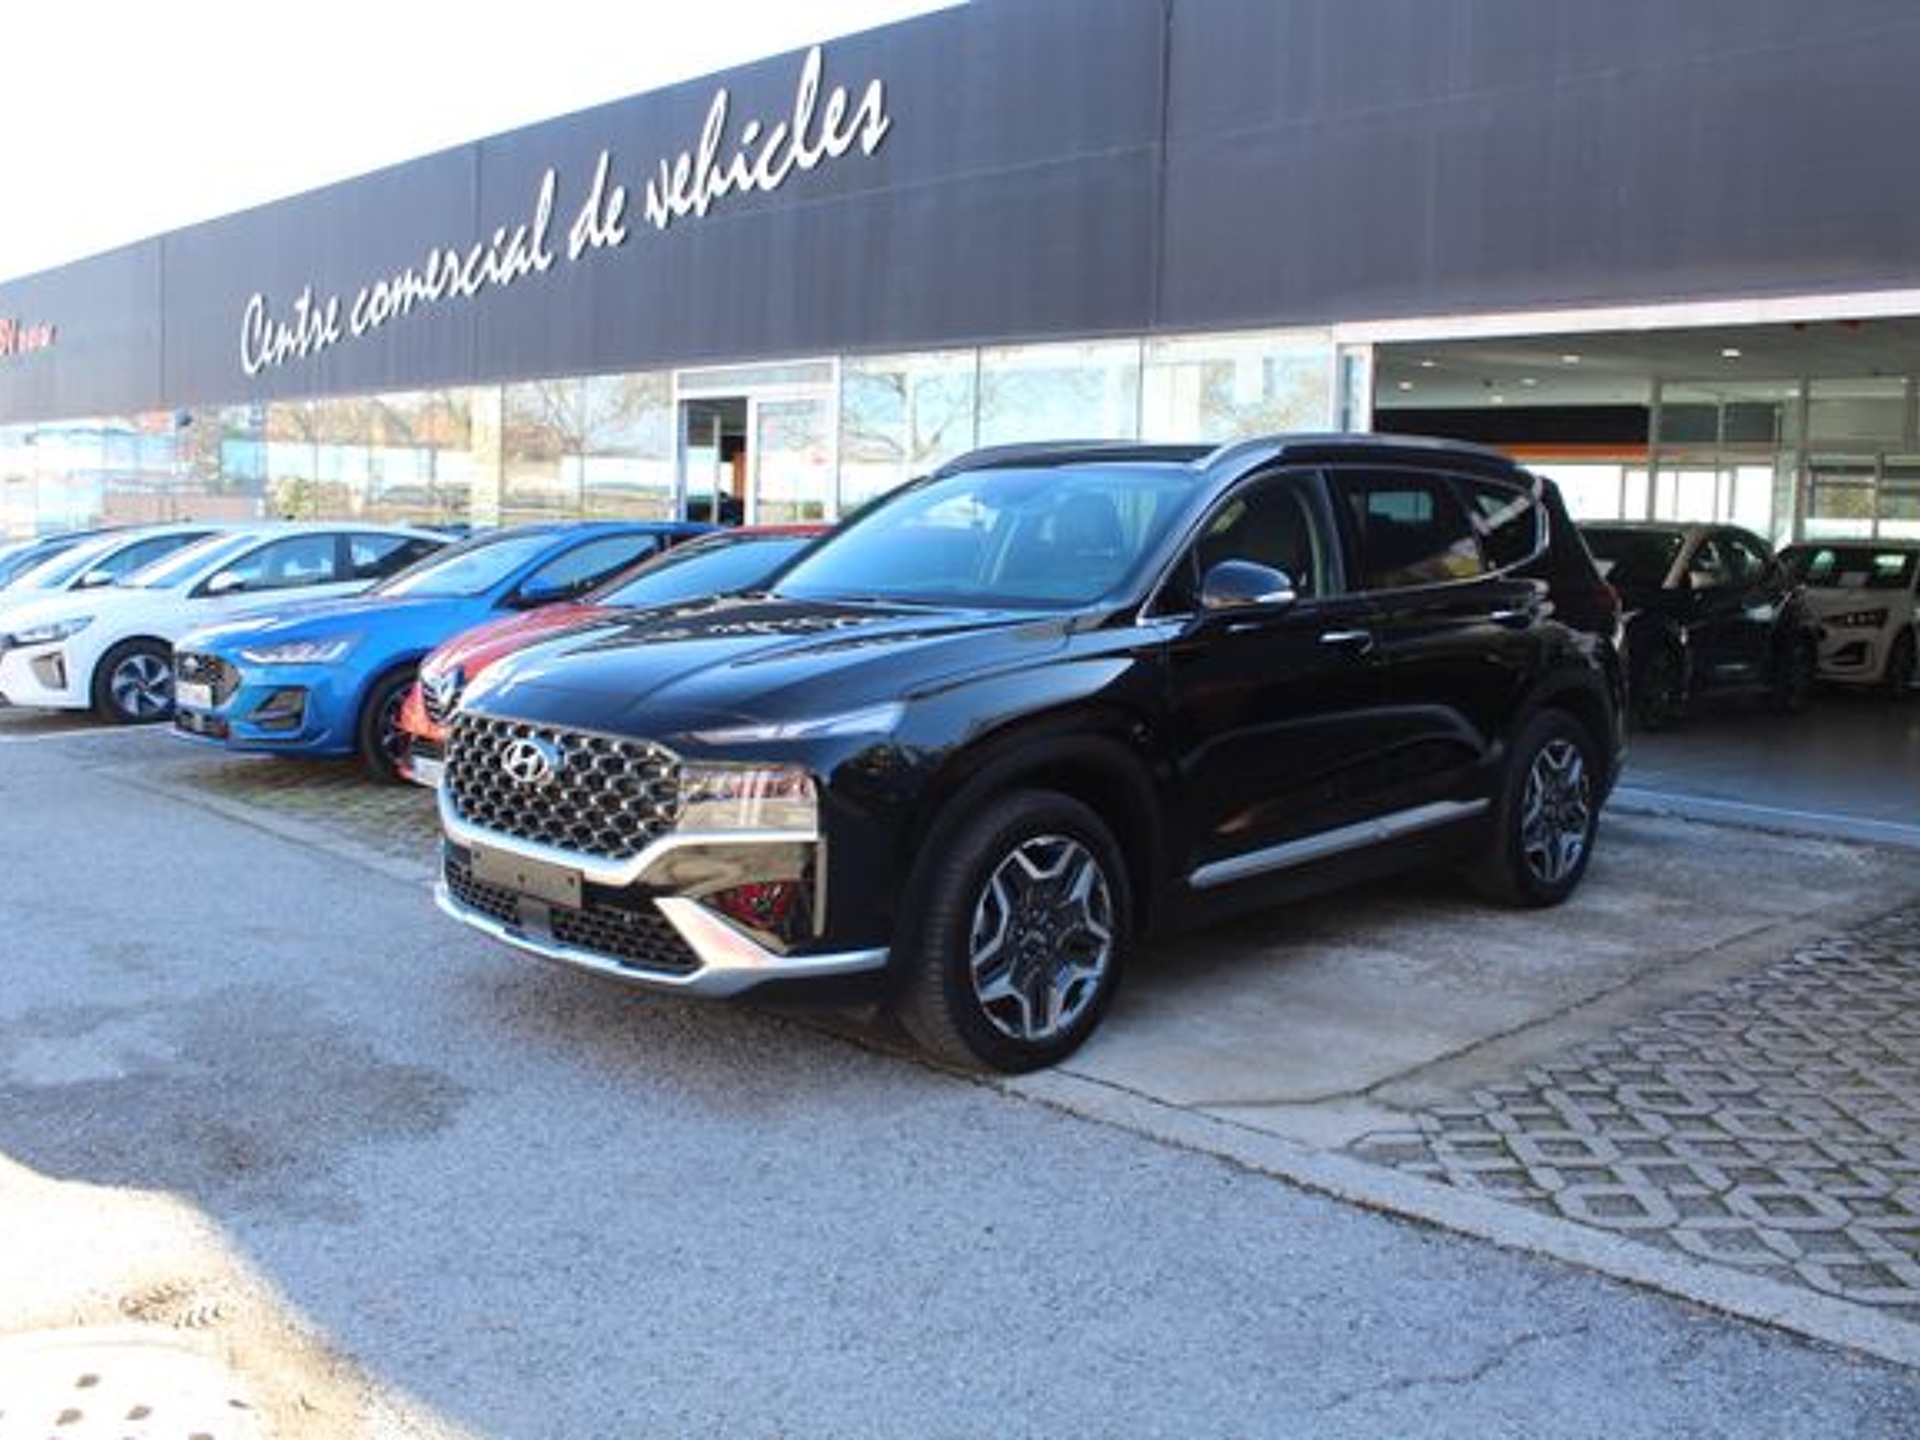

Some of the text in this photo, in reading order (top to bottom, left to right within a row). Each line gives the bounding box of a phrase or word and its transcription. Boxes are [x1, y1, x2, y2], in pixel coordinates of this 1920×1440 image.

[240, 45, 889, 375] Centre comercial de vehicles
